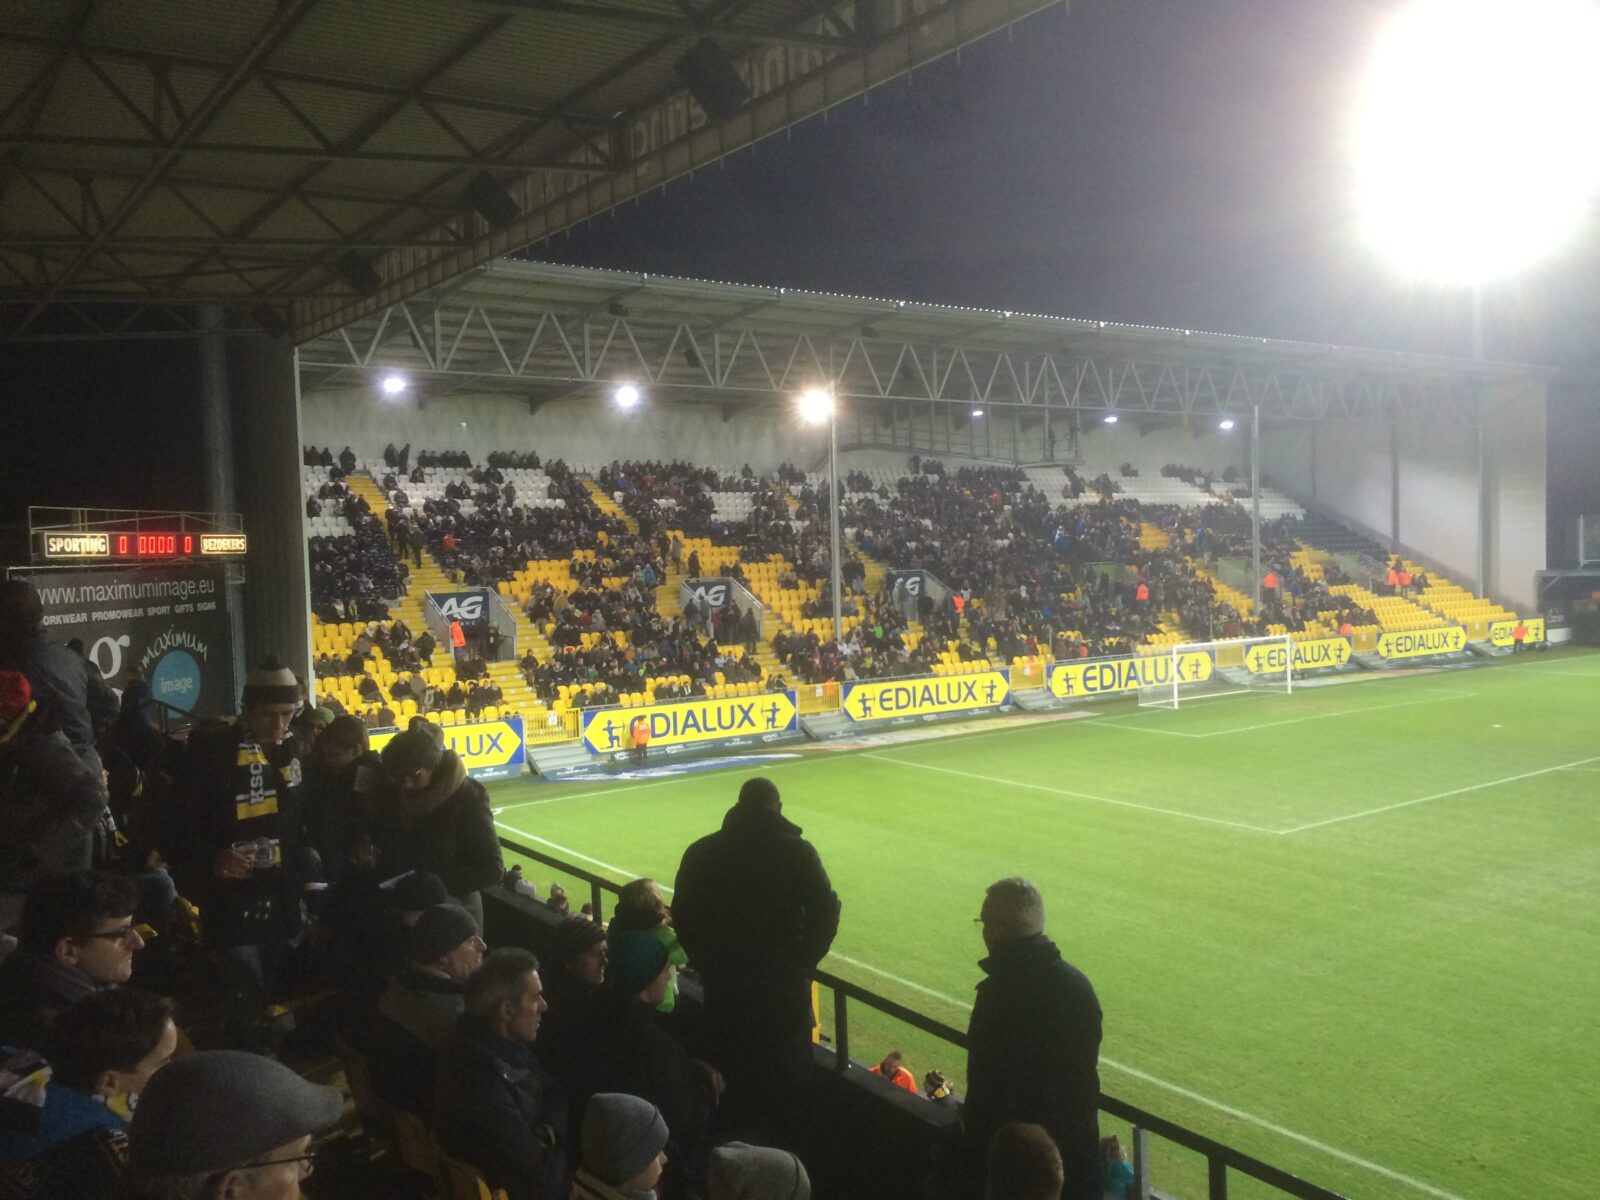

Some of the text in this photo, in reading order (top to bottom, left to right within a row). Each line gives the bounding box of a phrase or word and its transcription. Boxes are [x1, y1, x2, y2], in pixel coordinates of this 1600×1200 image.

[49, 537, 106, 552] SPORTING
[119, 536, 127, 553] 0
[184, 536, 192, 553] 0
[203, 538, 245, 551] BEZOEKERS
[43, 612, 88, 626] ORKWEAR
[92, 607, 144, 621] PROMOWEAR
[147, 605, 171, 617] SPORT
[175, 603, 194, 614] GIFTS
[441, 596, 483, 620] AG
[1396, 632, 1449, 653] EDIALUX
[160, 676, 193, 694] image
[1083, 656, 1186, 692] EDIALUX
[879, 680, 978, 711] EDIALUX
[250, 762, 265, 805] KSC
